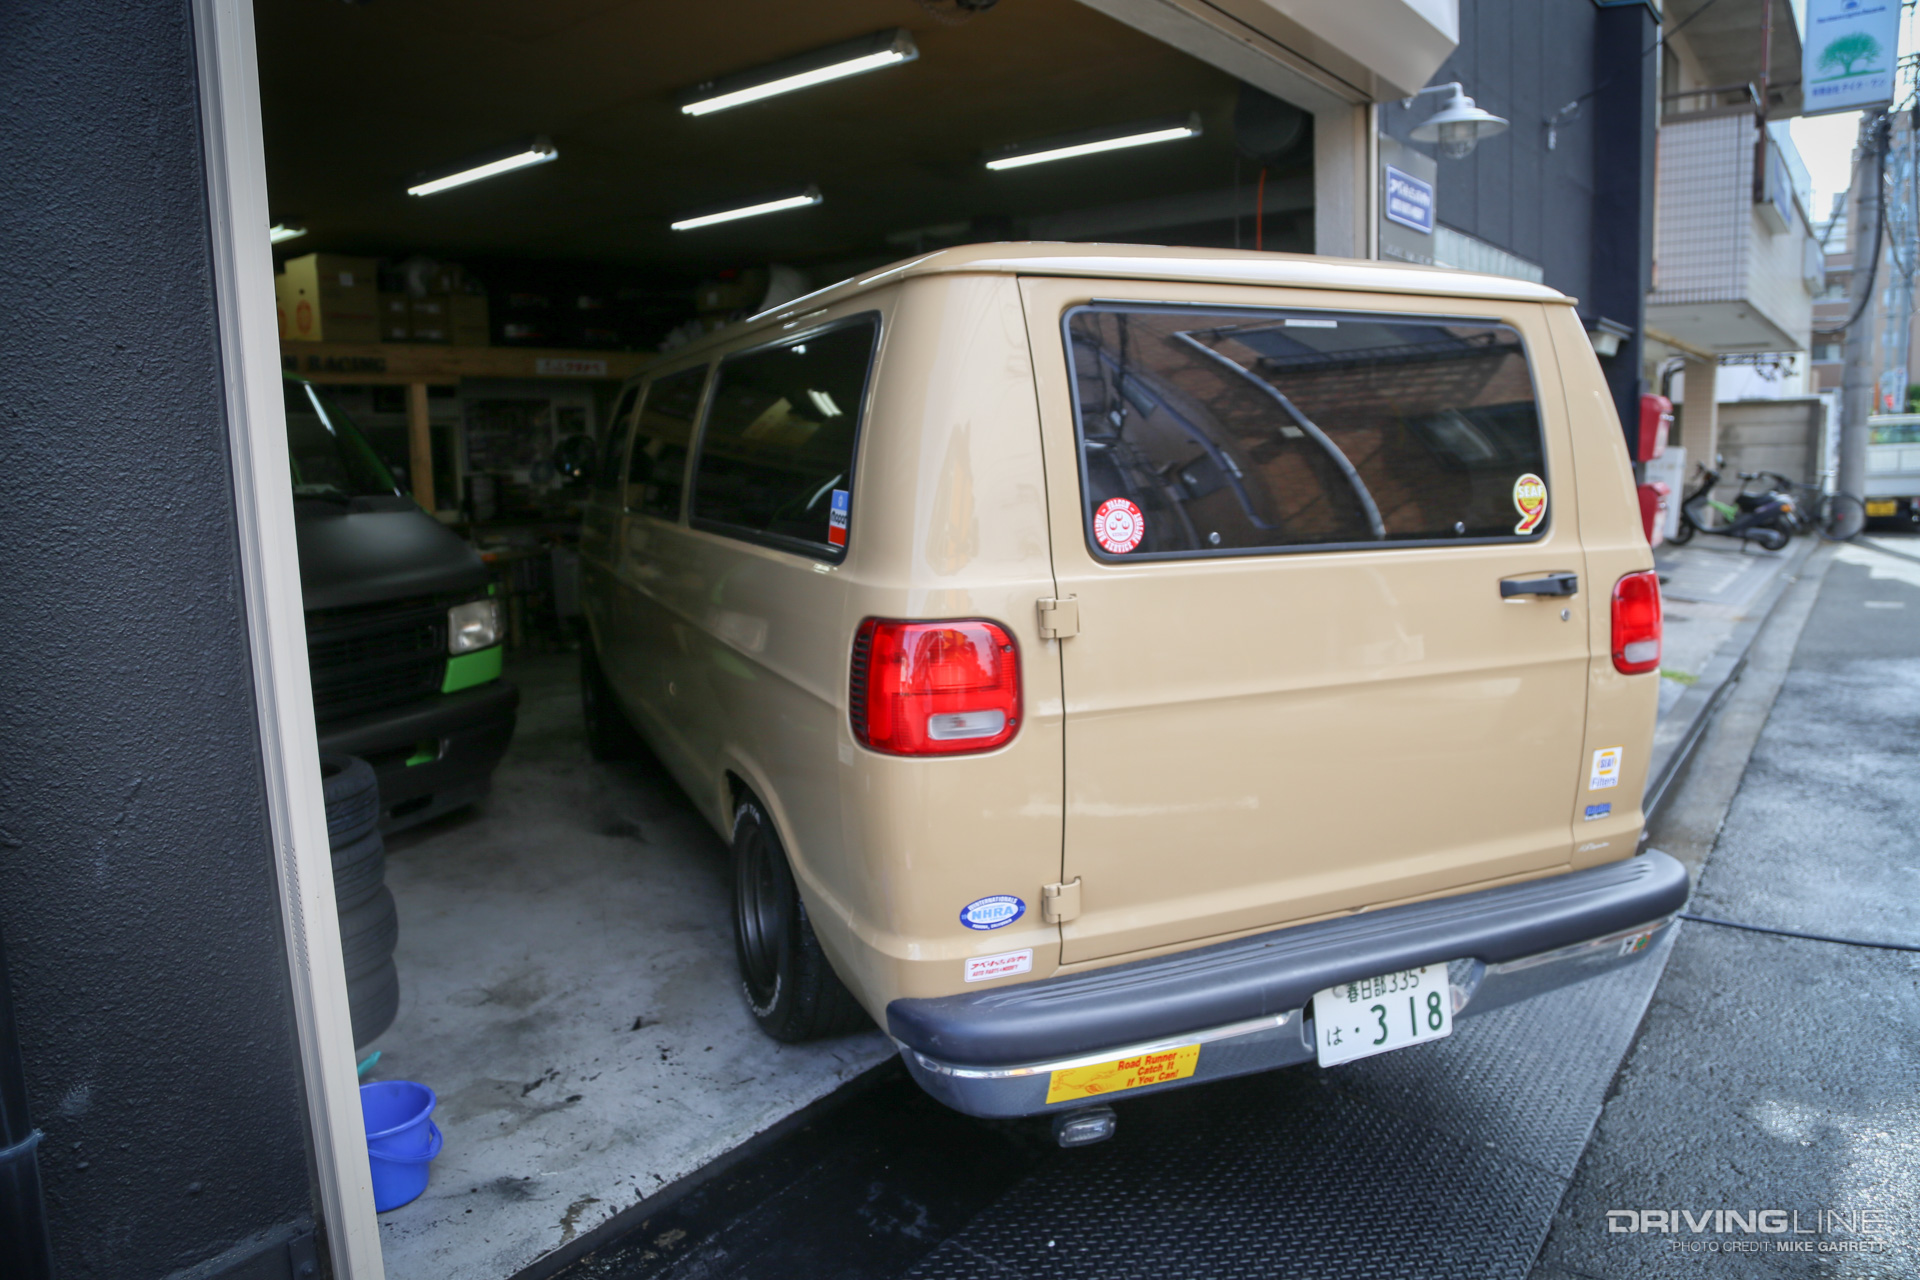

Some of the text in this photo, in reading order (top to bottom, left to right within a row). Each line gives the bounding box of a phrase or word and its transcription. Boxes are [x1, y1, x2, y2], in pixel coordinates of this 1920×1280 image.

[308, 355, 387, 372] RACING
[972, 905, 1014, 920] NHRA
[1118, 1056, 1142, 1071] Road
[1137, 1061, 1175, 1076] Catch It
[1126, 1068, 1180, 1087] If You Can!
